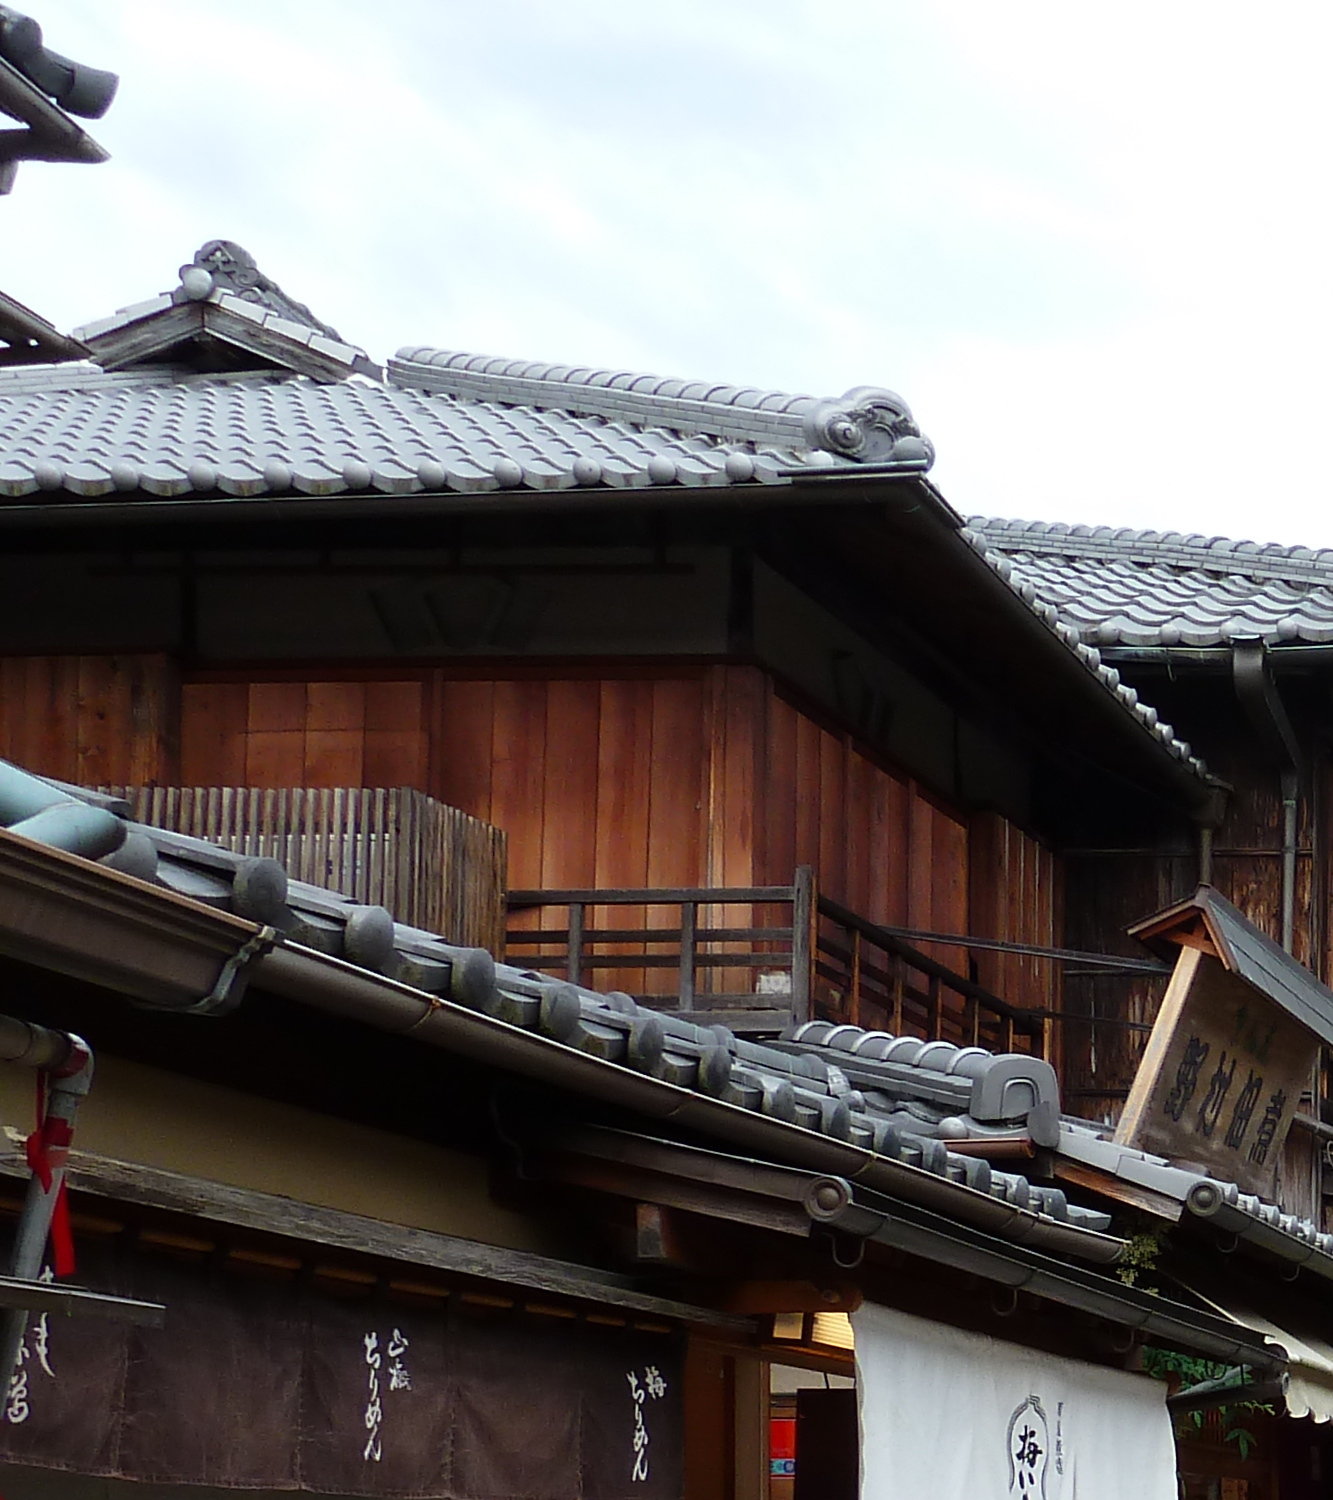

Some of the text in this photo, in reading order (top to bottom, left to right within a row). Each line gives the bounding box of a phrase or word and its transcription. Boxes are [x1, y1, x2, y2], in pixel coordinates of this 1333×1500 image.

[363, 1331, 383, 1463] ちりめん
[626, 1370, 649, 1482] ちりめん
